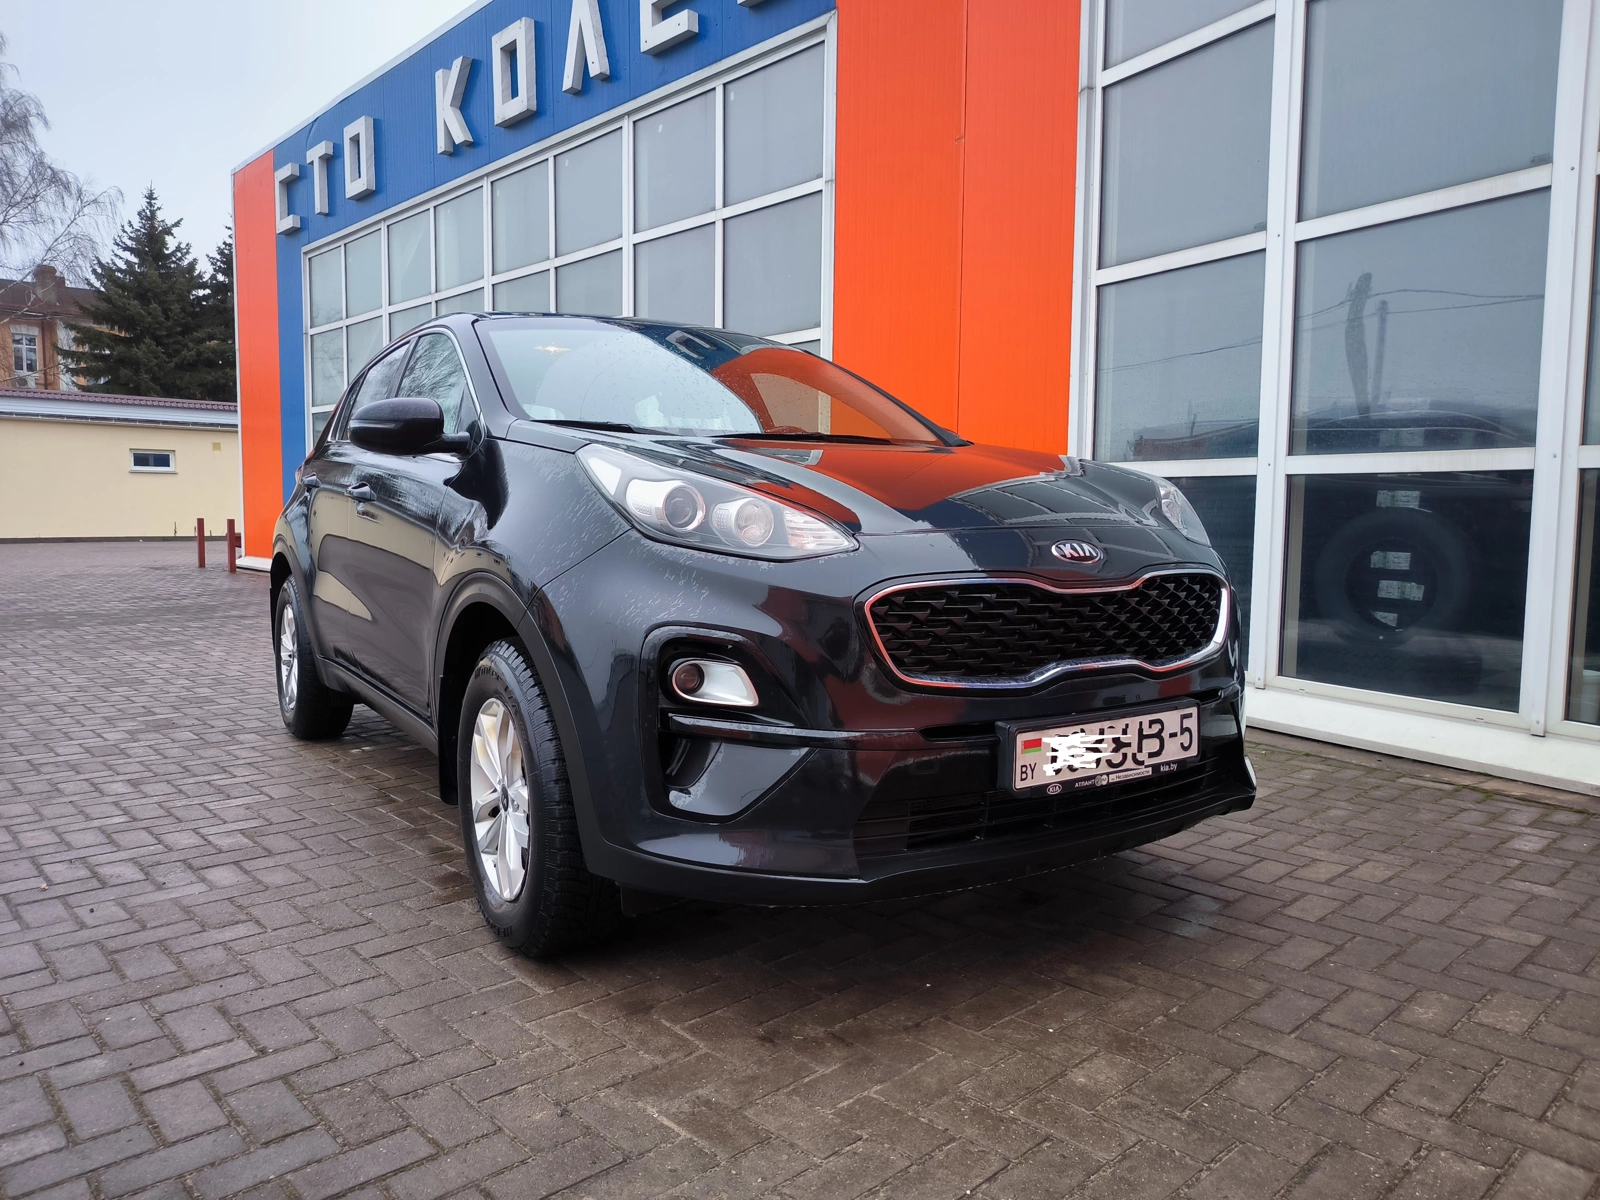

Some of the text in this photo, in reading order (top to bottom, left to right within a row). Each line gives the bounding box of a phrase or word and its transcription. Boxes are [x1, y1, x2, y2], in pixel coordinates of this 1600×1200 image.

[274, 0, 764, 236] СТО КОЛЕ
[1058, 543, 1097, 558] KIA
[1020, 763, 1037, 782] BY
[1160, 763, 1178, 773] kia.by
